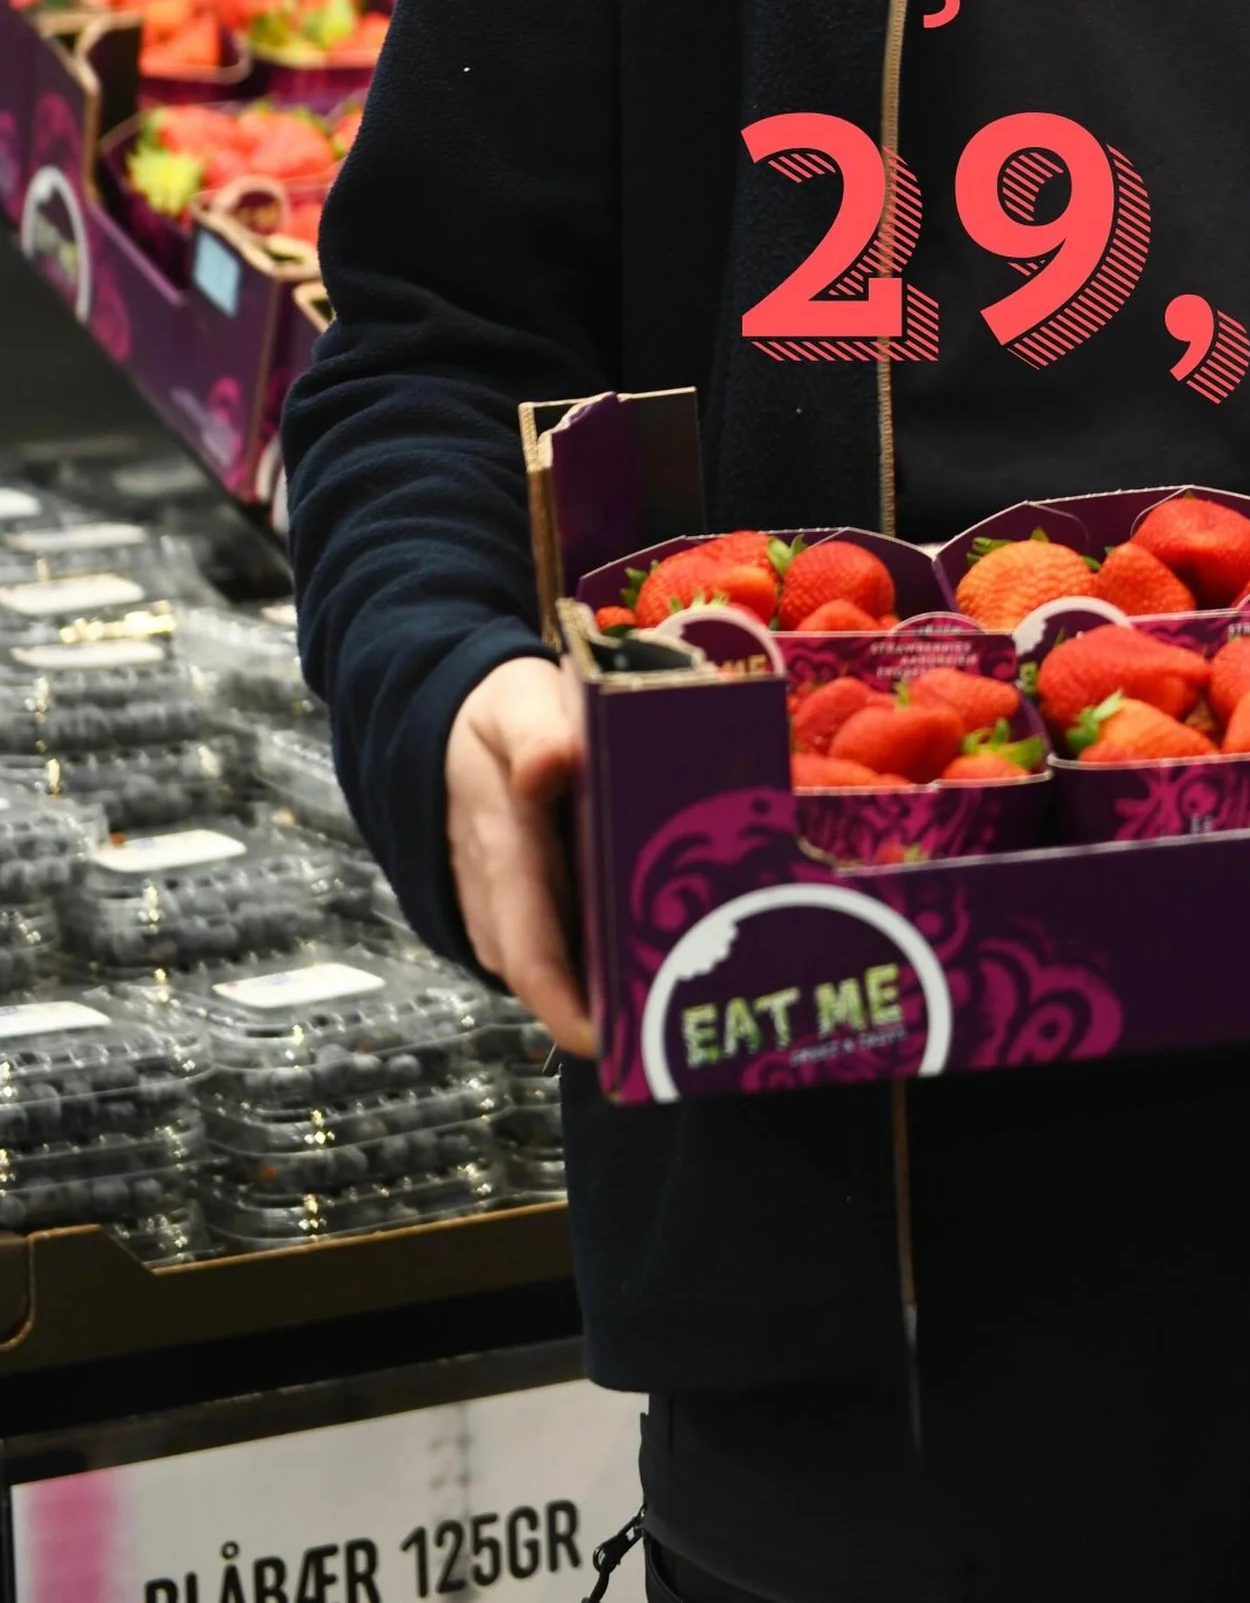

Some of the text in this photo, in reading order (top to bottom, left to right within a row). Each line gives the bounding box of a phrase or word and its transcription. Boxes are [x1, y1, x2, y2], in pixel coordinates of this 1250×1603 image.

[682, 986, 801, 1069] EAT
[814, 962, 904, 1040] ME
[400, 1499, 581, 1599] 125GR
